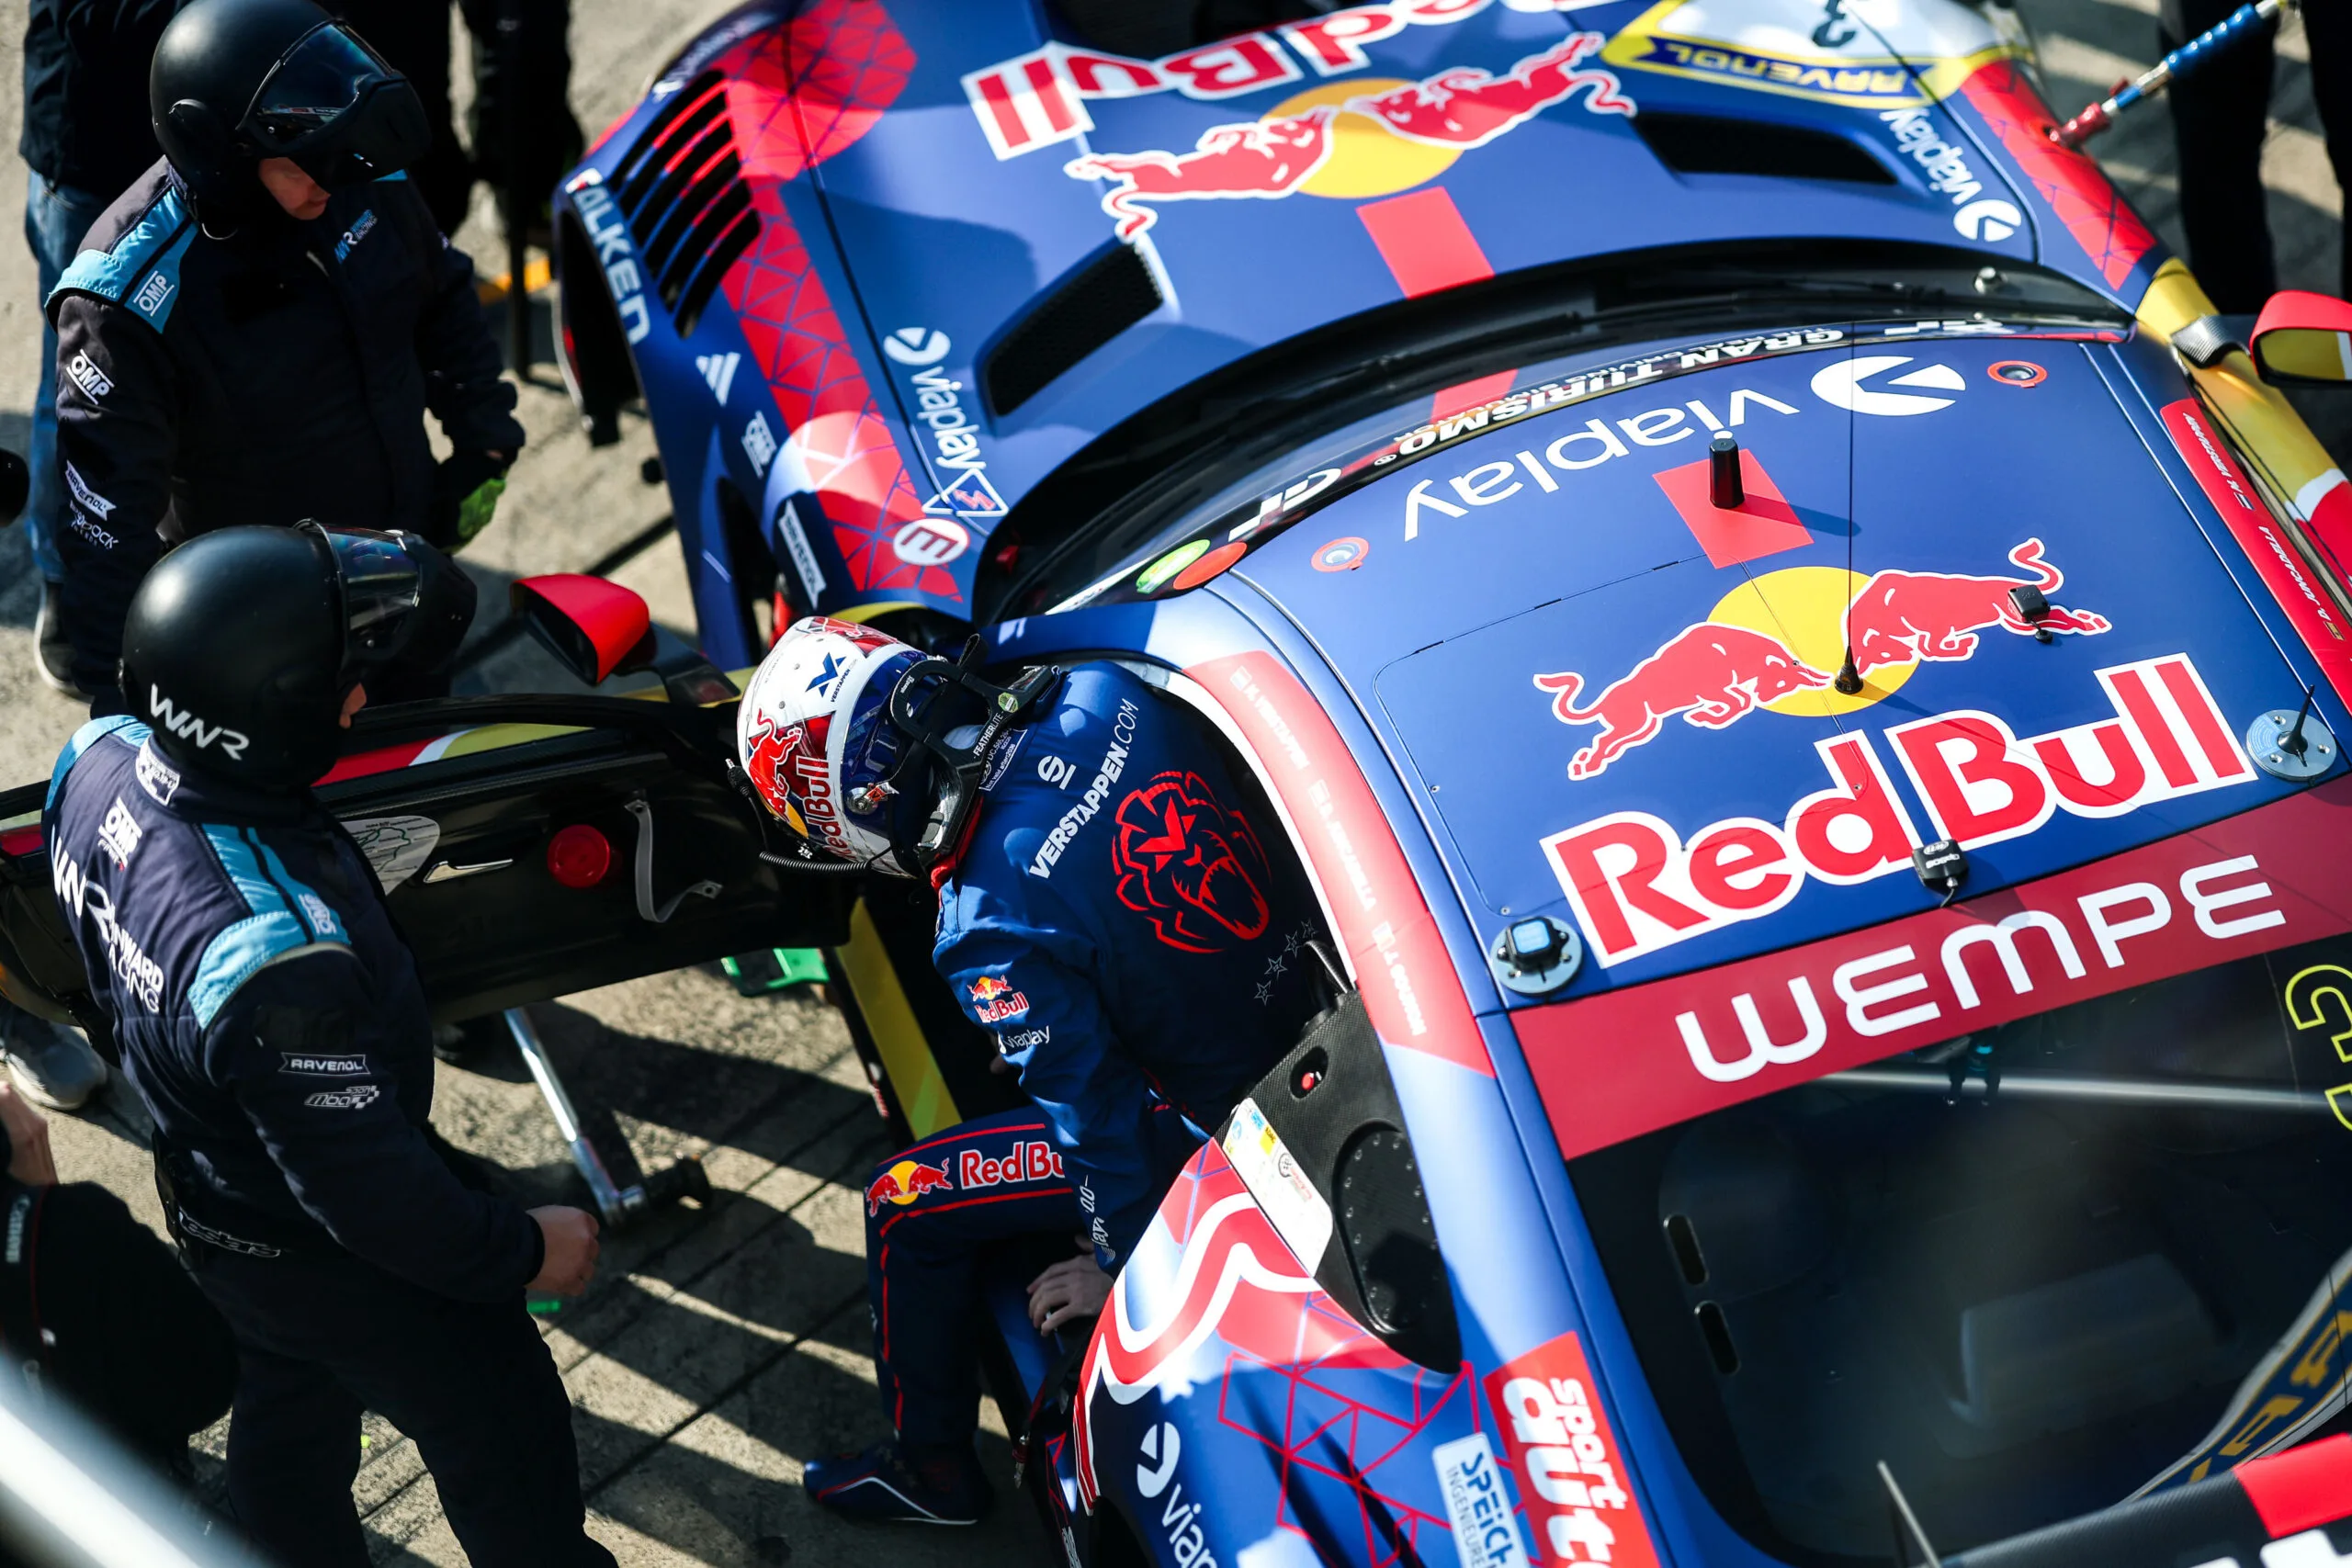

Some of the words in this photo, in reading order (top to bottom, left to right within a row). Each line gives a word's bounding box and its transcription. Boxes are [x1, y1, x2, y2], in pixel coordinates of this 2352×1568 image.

[1665, 42, 1908, 93] RAVENOL
[1880, 107, 1983, 206] viaplay
[137, 273, 168, 313] OMP
[1680, 328, 1845, 369] GRAN
[70, 355, 111, 397] OMP
[910, 366, 987, 470] viaplay
[67, 469, 107, 512] RAVENOL
[1403, 389, 1801, 543] viaplay
[972, 711, 1004, 757] FEATHERLITE
[796, 754, 837, 818] Bull
[1028, 697, 1139, 879] VERSTAPPEN.COM
[1540, 729, 1938, 968] Red
[1885, 653, 2257, 854] Bull
[103, 802, 141, 857] OMP
[1675, 854, 2287, 1083] WEMPE
[994, 991, 1030, 1020] Bull
[1002, 1025, 1050, 1048] viaplay
[290, 1057, 363, 1073] RAVENOL
[959, 1141, 1025, 1190] Red
[1024, 1141, 1066, 1182] Bu
[1549, 1377, 1629, 1510] sport
[1501, 1376, 1616, 1568] aut
